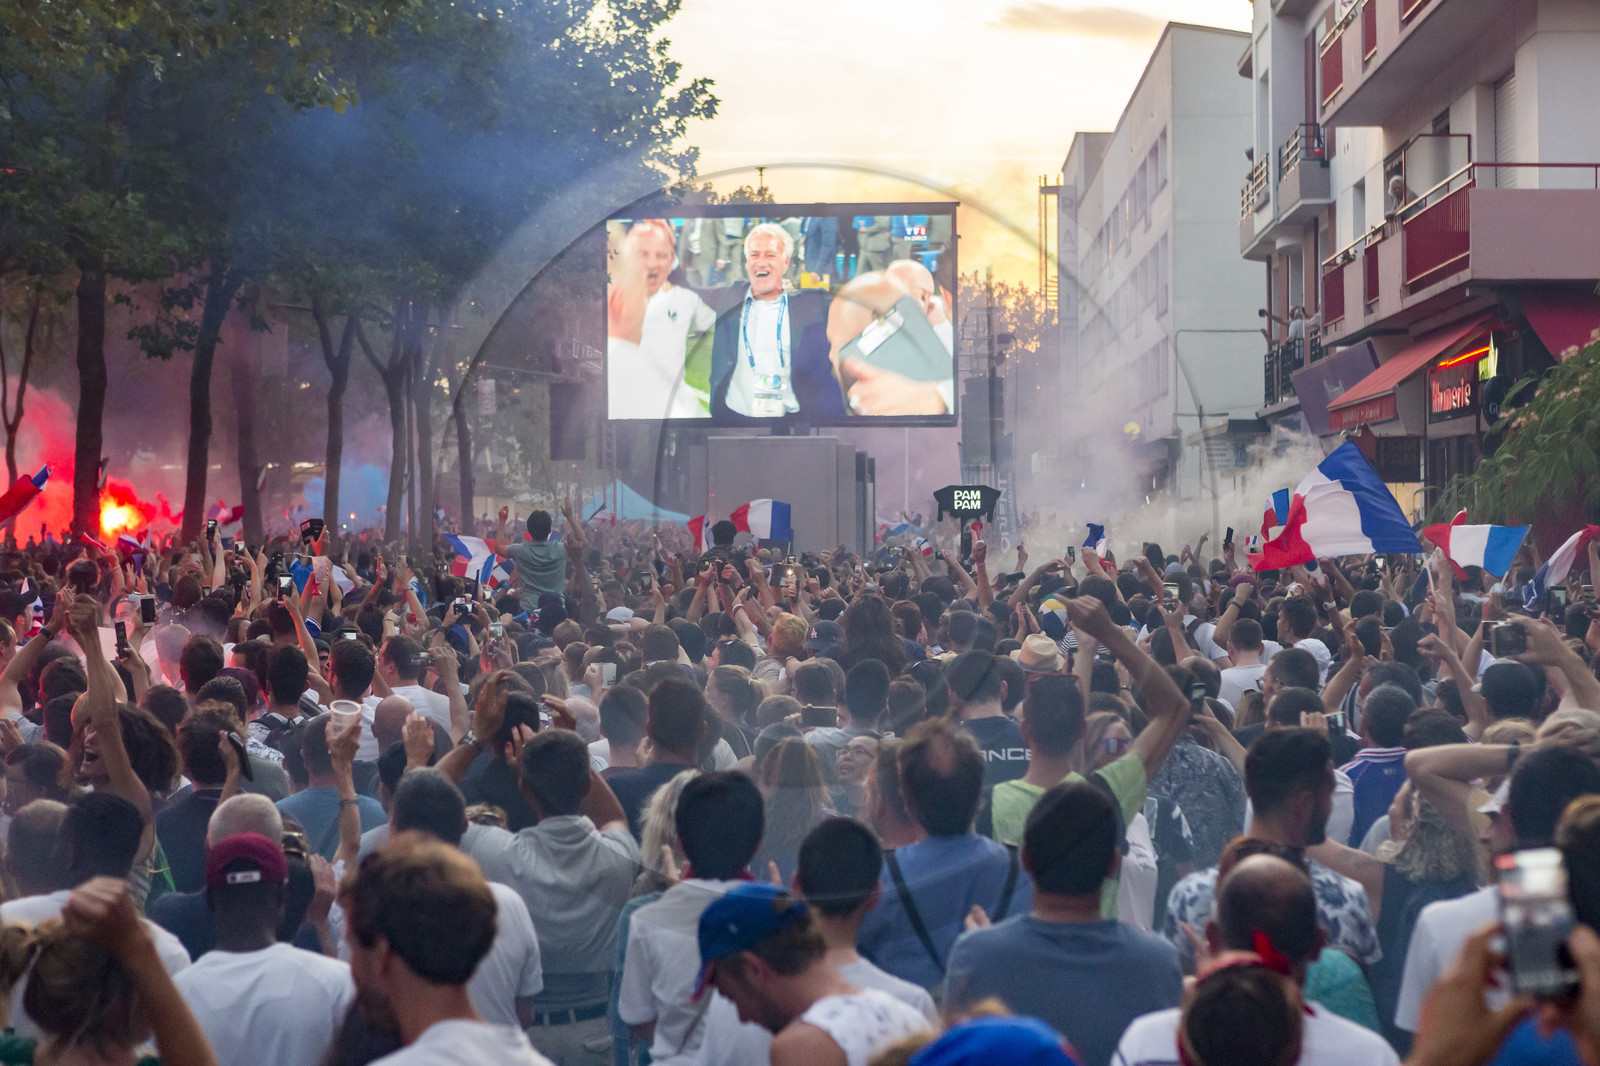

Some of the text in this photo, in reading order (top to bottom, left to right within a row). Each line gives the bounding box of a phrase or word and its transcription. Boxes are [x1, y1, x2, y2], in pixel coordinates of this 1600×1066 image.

[905, 227, 926, 235] TF1
[953, 490, 981, 500] PAM
[953, 500, 981, 510] PAM
